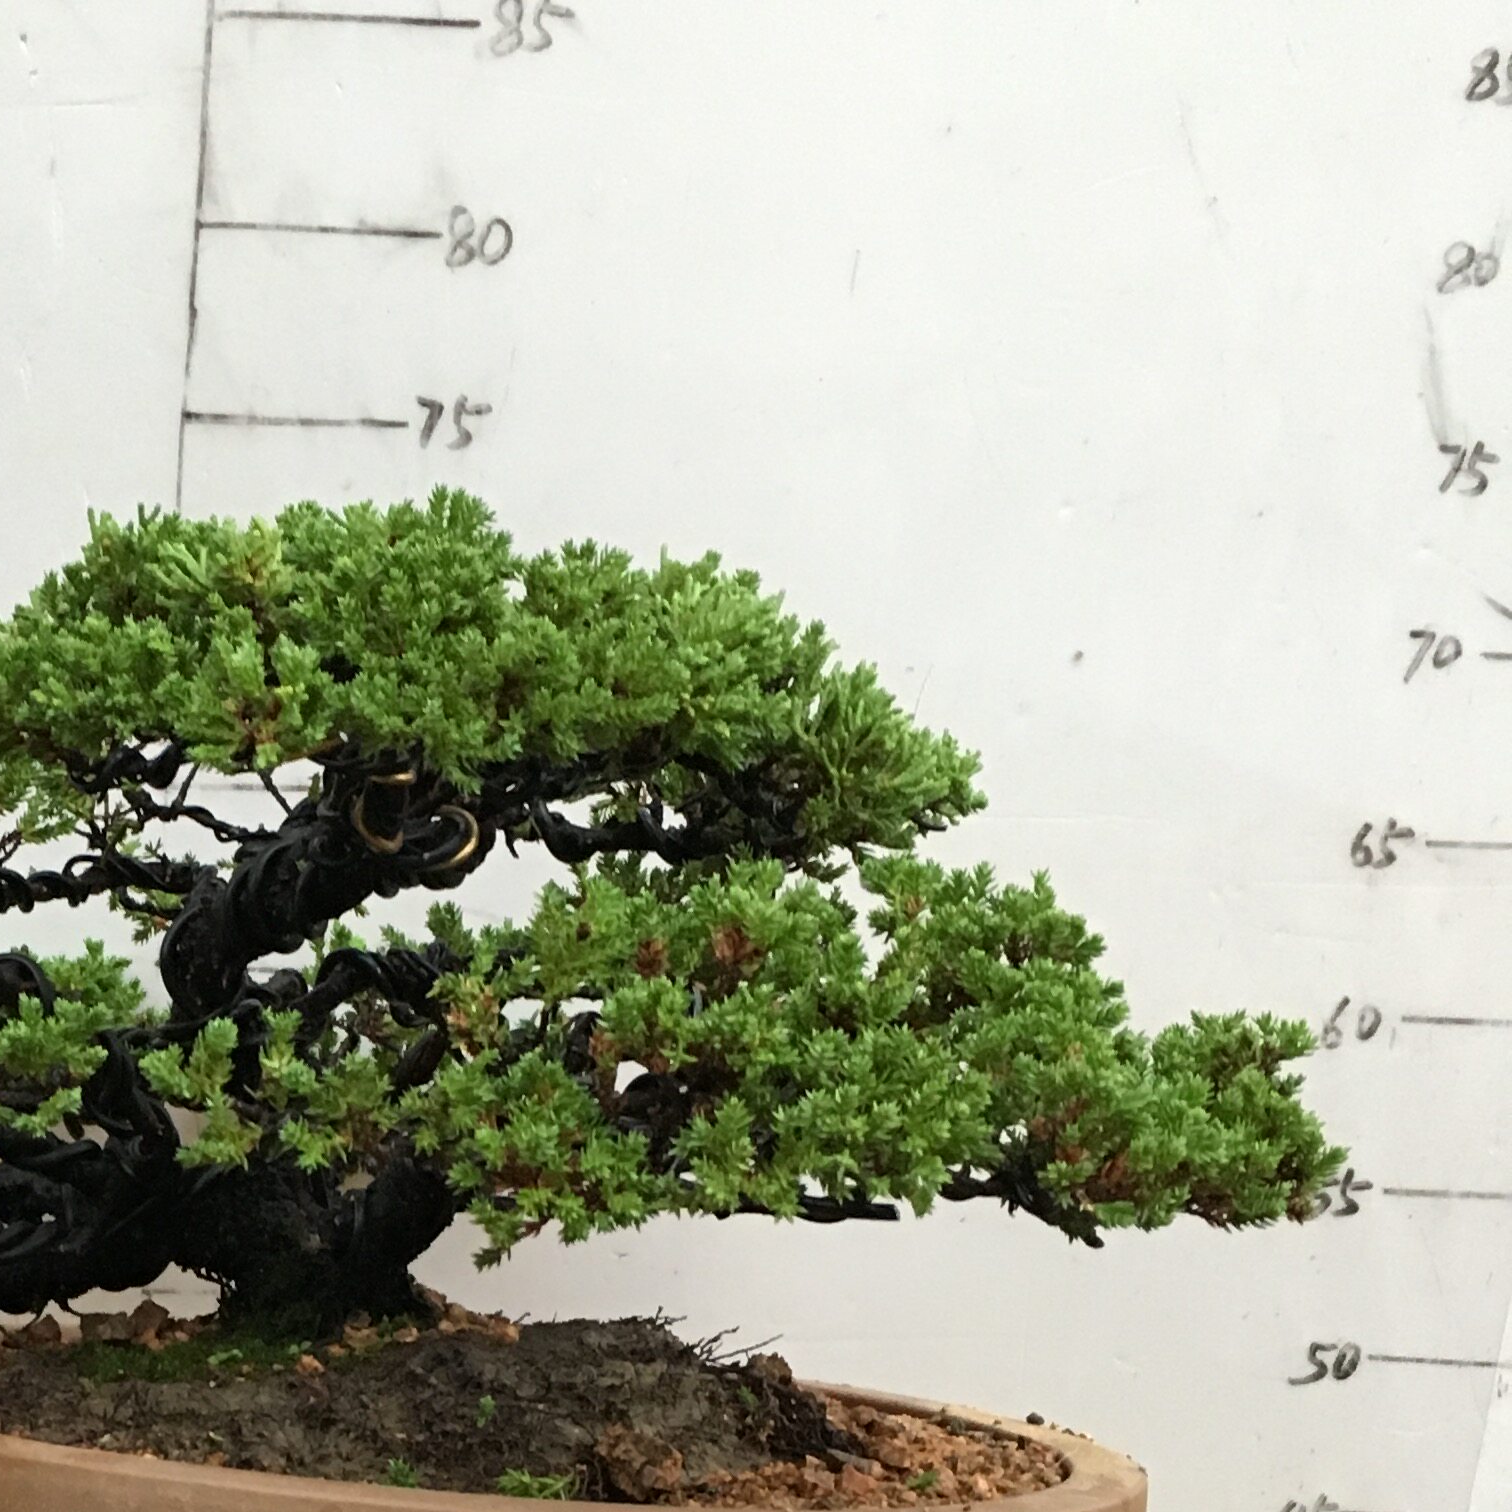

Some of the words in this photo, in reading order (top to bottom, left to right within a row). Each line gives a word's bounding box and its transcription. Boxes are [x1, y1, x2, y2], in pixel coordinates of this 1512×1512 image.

[491, 0, 575, 57] 85
[1465, 47, 1512, 104] 8
[446, 205, 514, 268] 80
[1437, 240, 1499, 292] 80
[417, 395, 493, 450] 75
[1439, 441, 1500, 493] 75
[1403, 629, 1462, 684] 70
[1351, 817, 1416, 870] 65
[1322, 996, 1382, 1049] 60
[1288, 1340, 1361, 1385] 50
